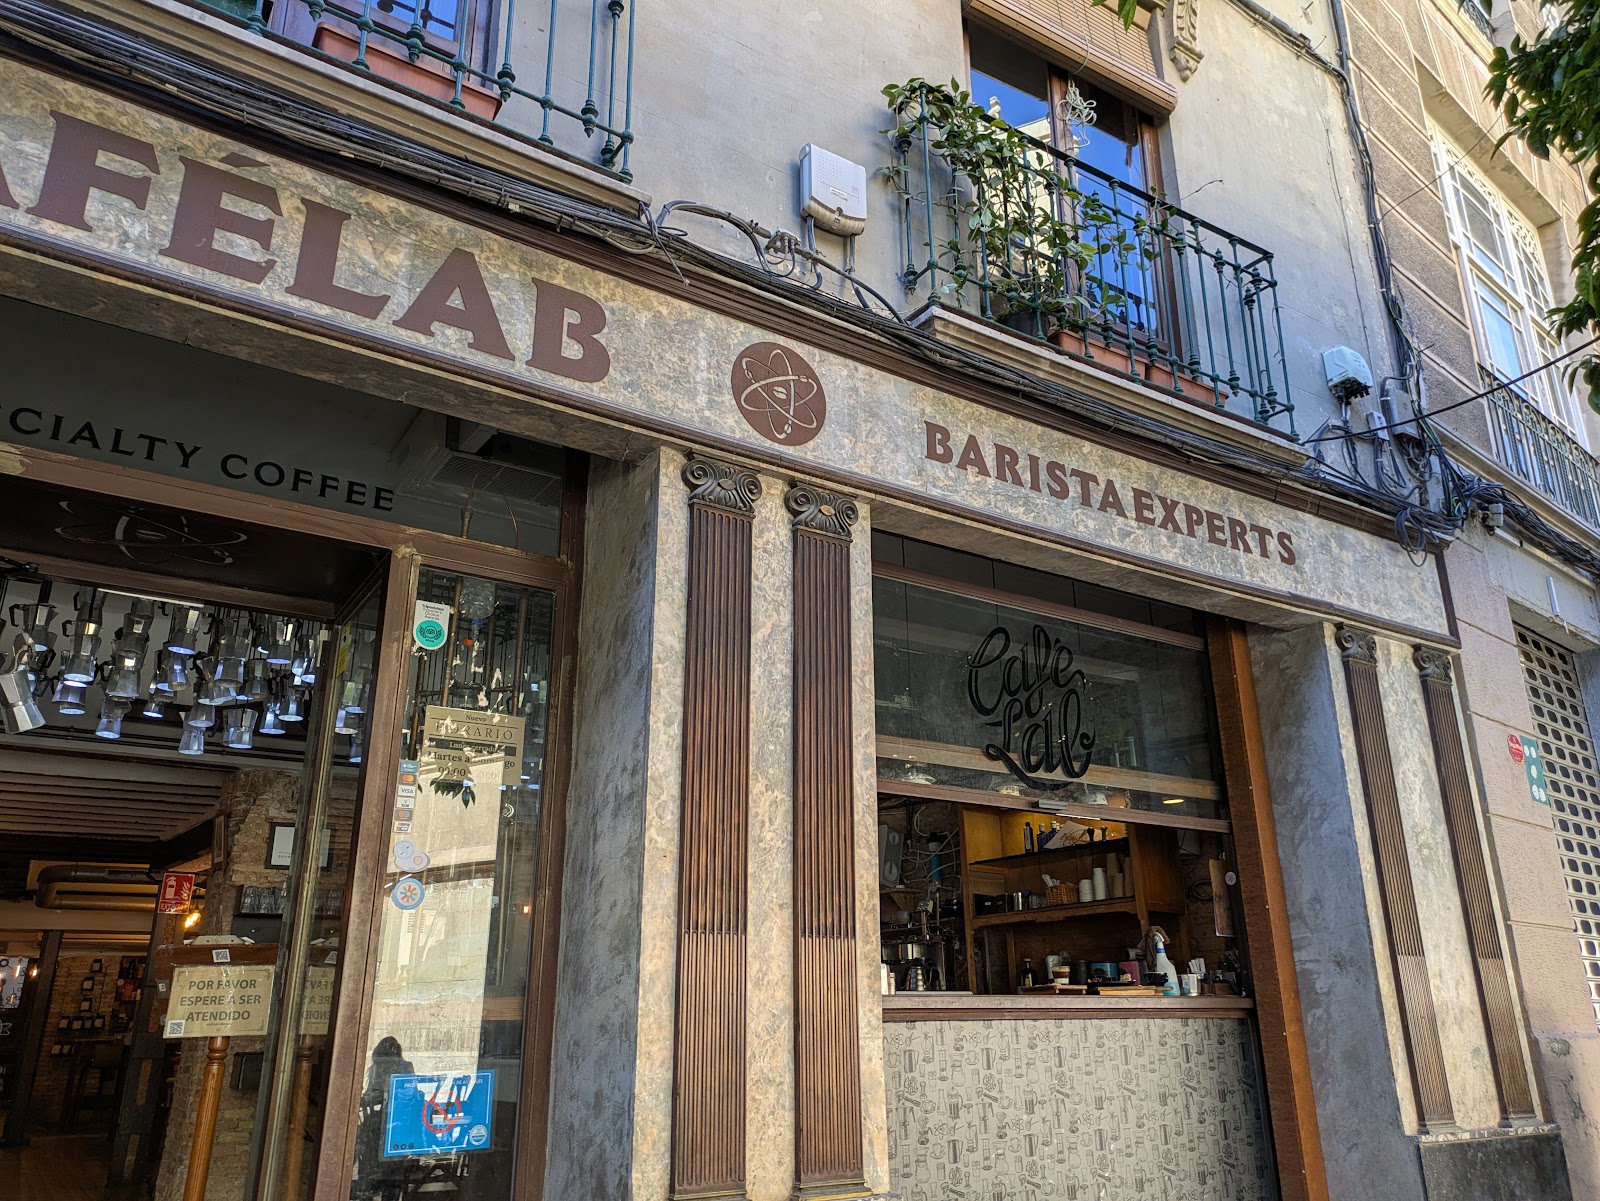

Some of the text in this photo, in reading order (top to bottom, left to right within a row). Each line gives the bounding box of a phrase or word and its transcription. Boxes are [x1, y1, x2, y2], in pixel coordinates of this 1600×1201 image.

[0, 110, 611, 383] FÉLAB
[0, 404, 395, 512] CIALTY COFFEE
[465, 714, 487, 722] Nuevo
[983, 688, 1097, 791] Lab
[471, 745, 497, 753] cerrado
[464, 755, 470, 763] a
[472, 757, 516, 770] omigo
[188, 978, 257, 991] POR FAVOR
[179, 994, 262, 1007] ESPERE A SER
[185, 1010, 251, 1022] ATENDIDO
